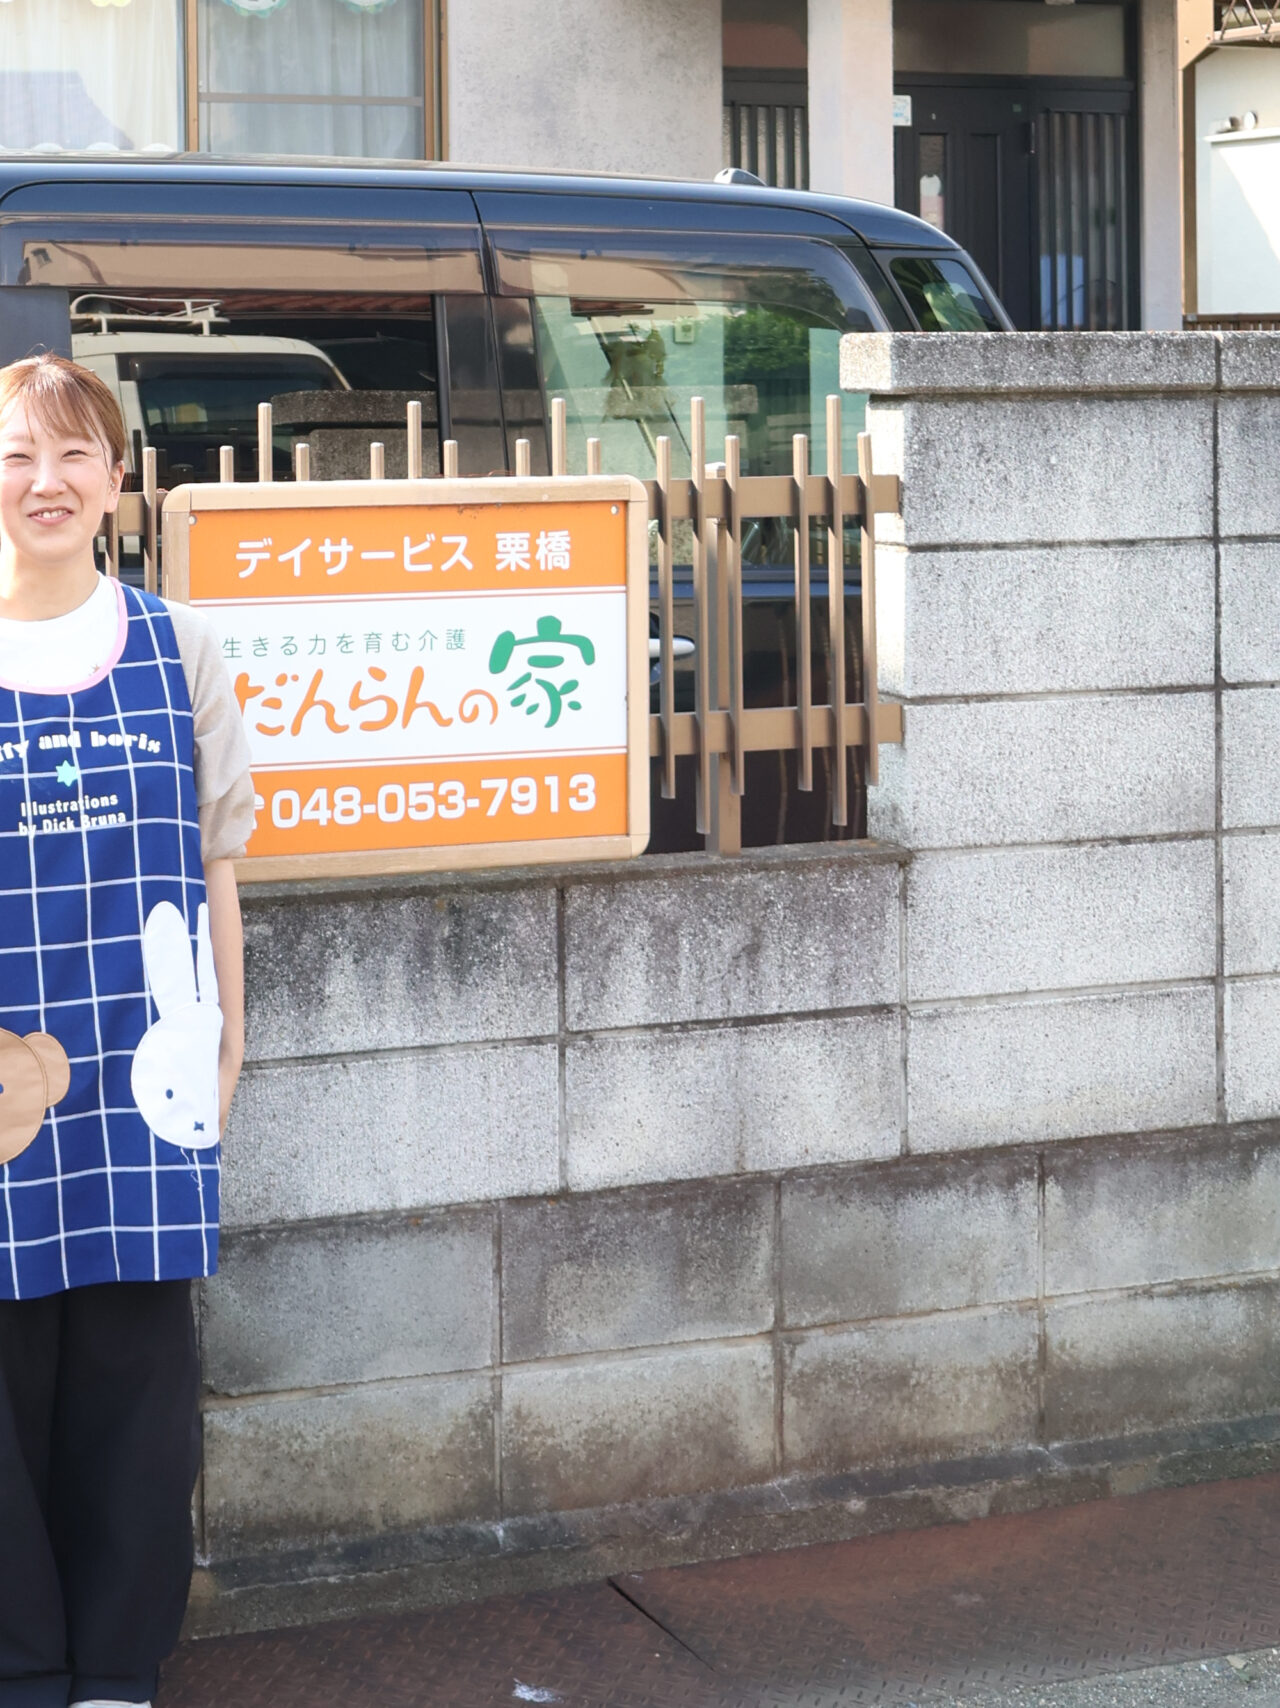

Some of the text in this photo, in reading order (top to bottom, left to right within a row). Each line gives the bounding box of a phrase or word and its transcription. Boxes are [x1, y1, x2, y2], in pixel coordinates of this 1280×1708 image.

[235, 530, 572, 579] デイサービス 栗橋
[222, 627, 467, 660] 生きる力を育む介護
[38, 730, 82, 750] and
[90, 730, 161, 754] boris
[20, 794, 119, 818] Illustrations
[271, 773, 597, 829] 048-053-7913
[18, 811, 127, 839] by Dick Bruna
